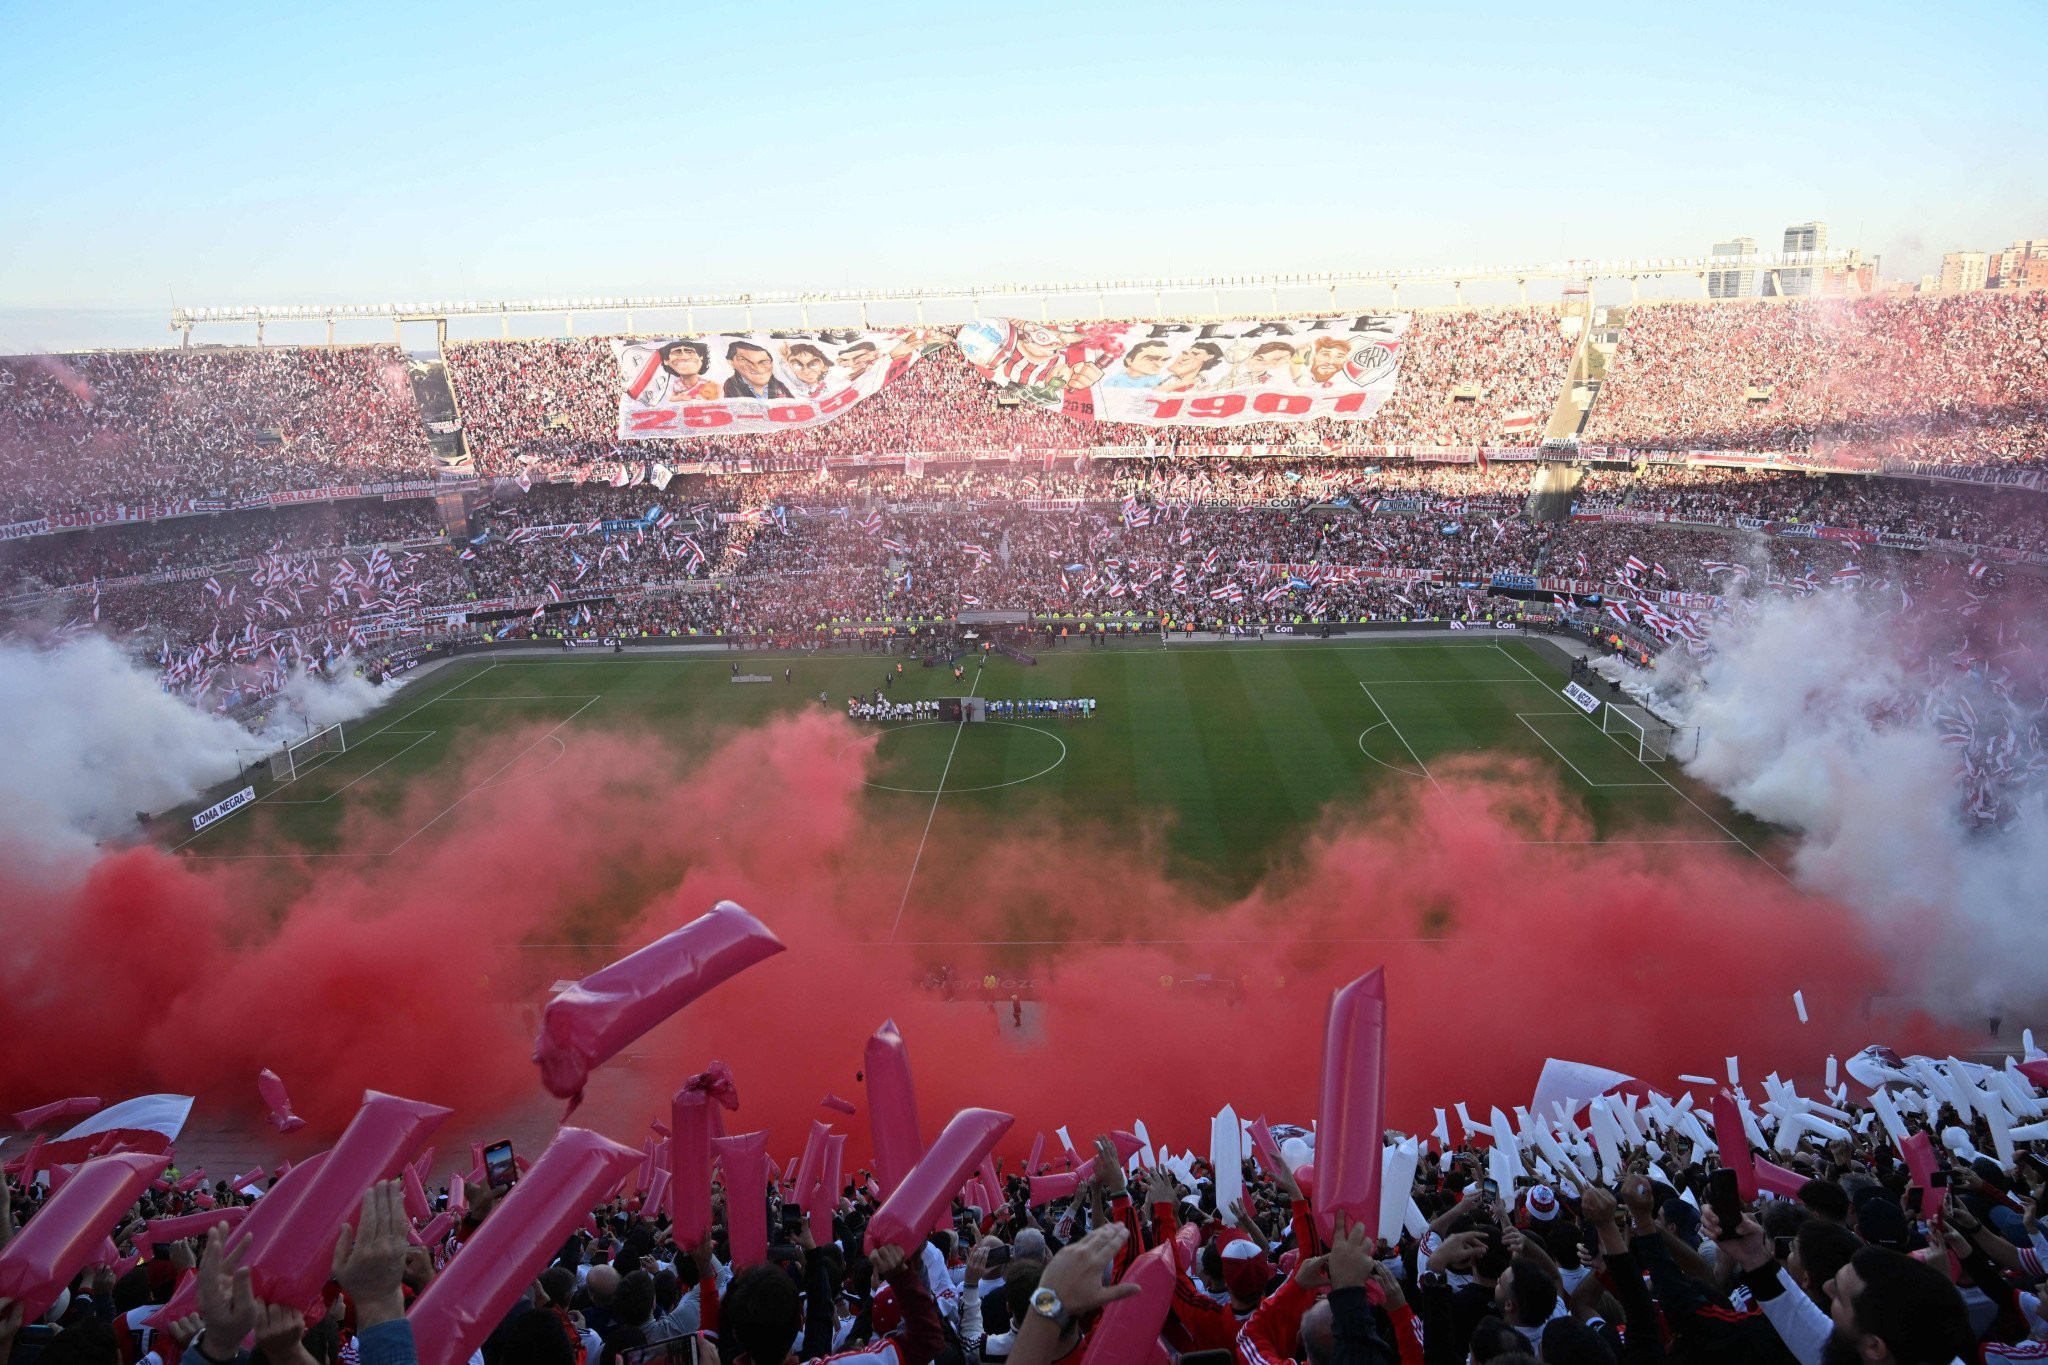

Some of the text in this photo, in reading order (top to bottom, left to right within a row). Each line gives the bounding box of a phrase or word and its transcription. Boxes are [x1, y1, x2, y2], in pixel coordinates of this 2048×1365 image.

[1146, 315, 1398, 339] PLATE
[1064, 400, 1093, 414] 2018
[1146, 392, 1367, 418] 1901
[936, 451, 972, 462] LINIERS
[1240, 445, 1253, 456] A
[1345, 446, 1387, 457] LUGANO
[271, 486, 359, 504] BERAZATEGUI
[1389, 501, 1417, 510] NORMAN
[48, 507, 120, 529] SOMOS
[125, 499, 193, 521] FIESTA
[1739, 518, 1765, 527] VILLA
[164, 566, 214, 583] MATADEROS
[1493, 575, 1534, 585] FLORES
[1540, 579, 1604, 595] VILLA ELISA
[1275, 625, 1293, 633] Con
[1496, 620, 1516, 629] Con
[406, 660, 418, 669] Con
[1577, 692, 1593, 709] NEGRA
[193, 793, 245, 828] LOMA NEGRA
